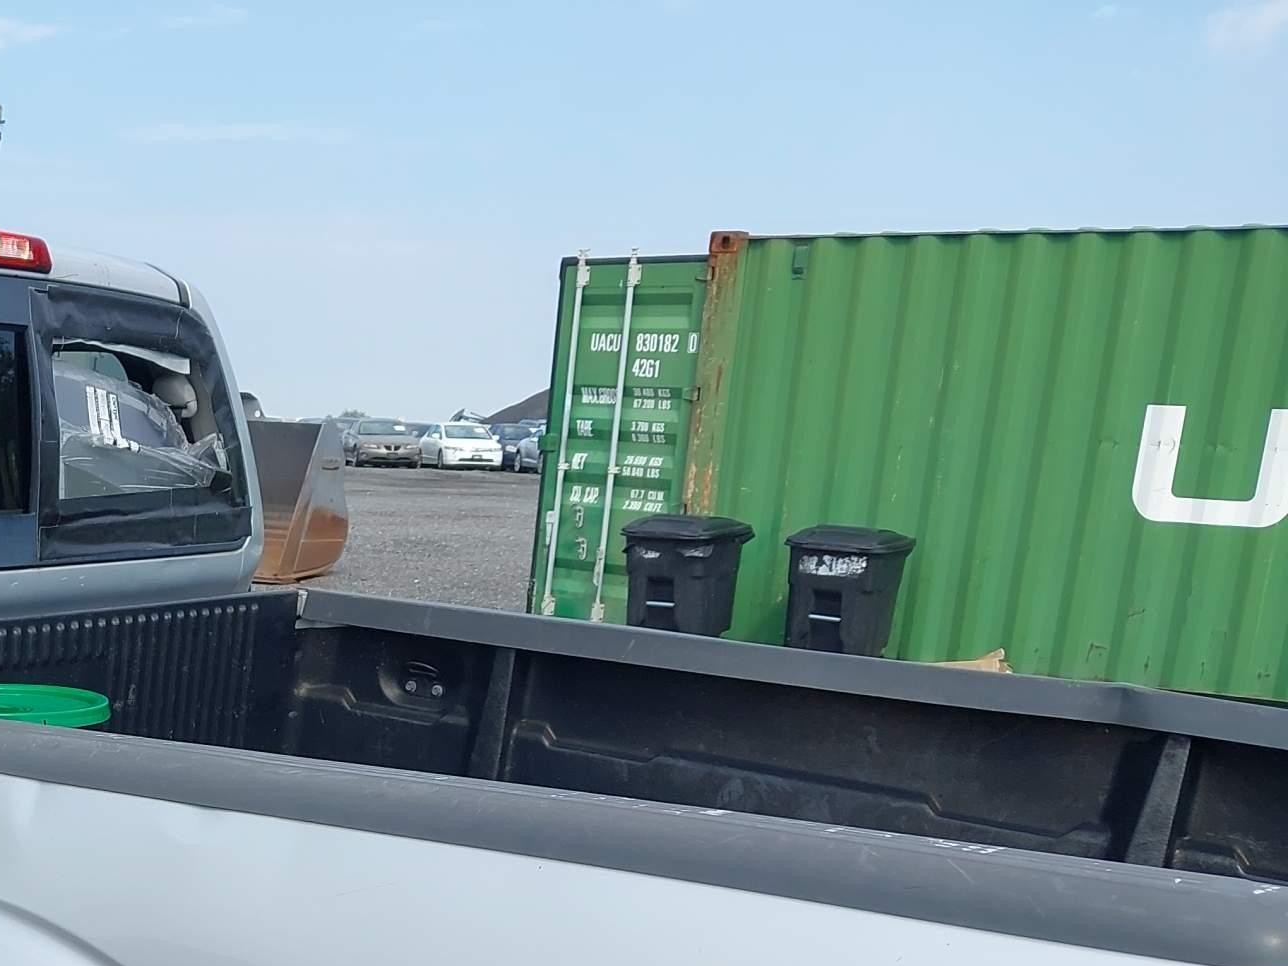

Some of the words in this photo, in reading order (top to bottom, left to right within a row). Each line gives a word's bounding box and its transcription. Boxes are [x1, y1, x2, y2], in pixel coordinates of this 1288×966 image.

[591, 333, 622, 352] UACU
[636, 333, 680, 353] 830182
[632, 358, 660, 378] 42G1
[1132, 404, 1288, 528] U
